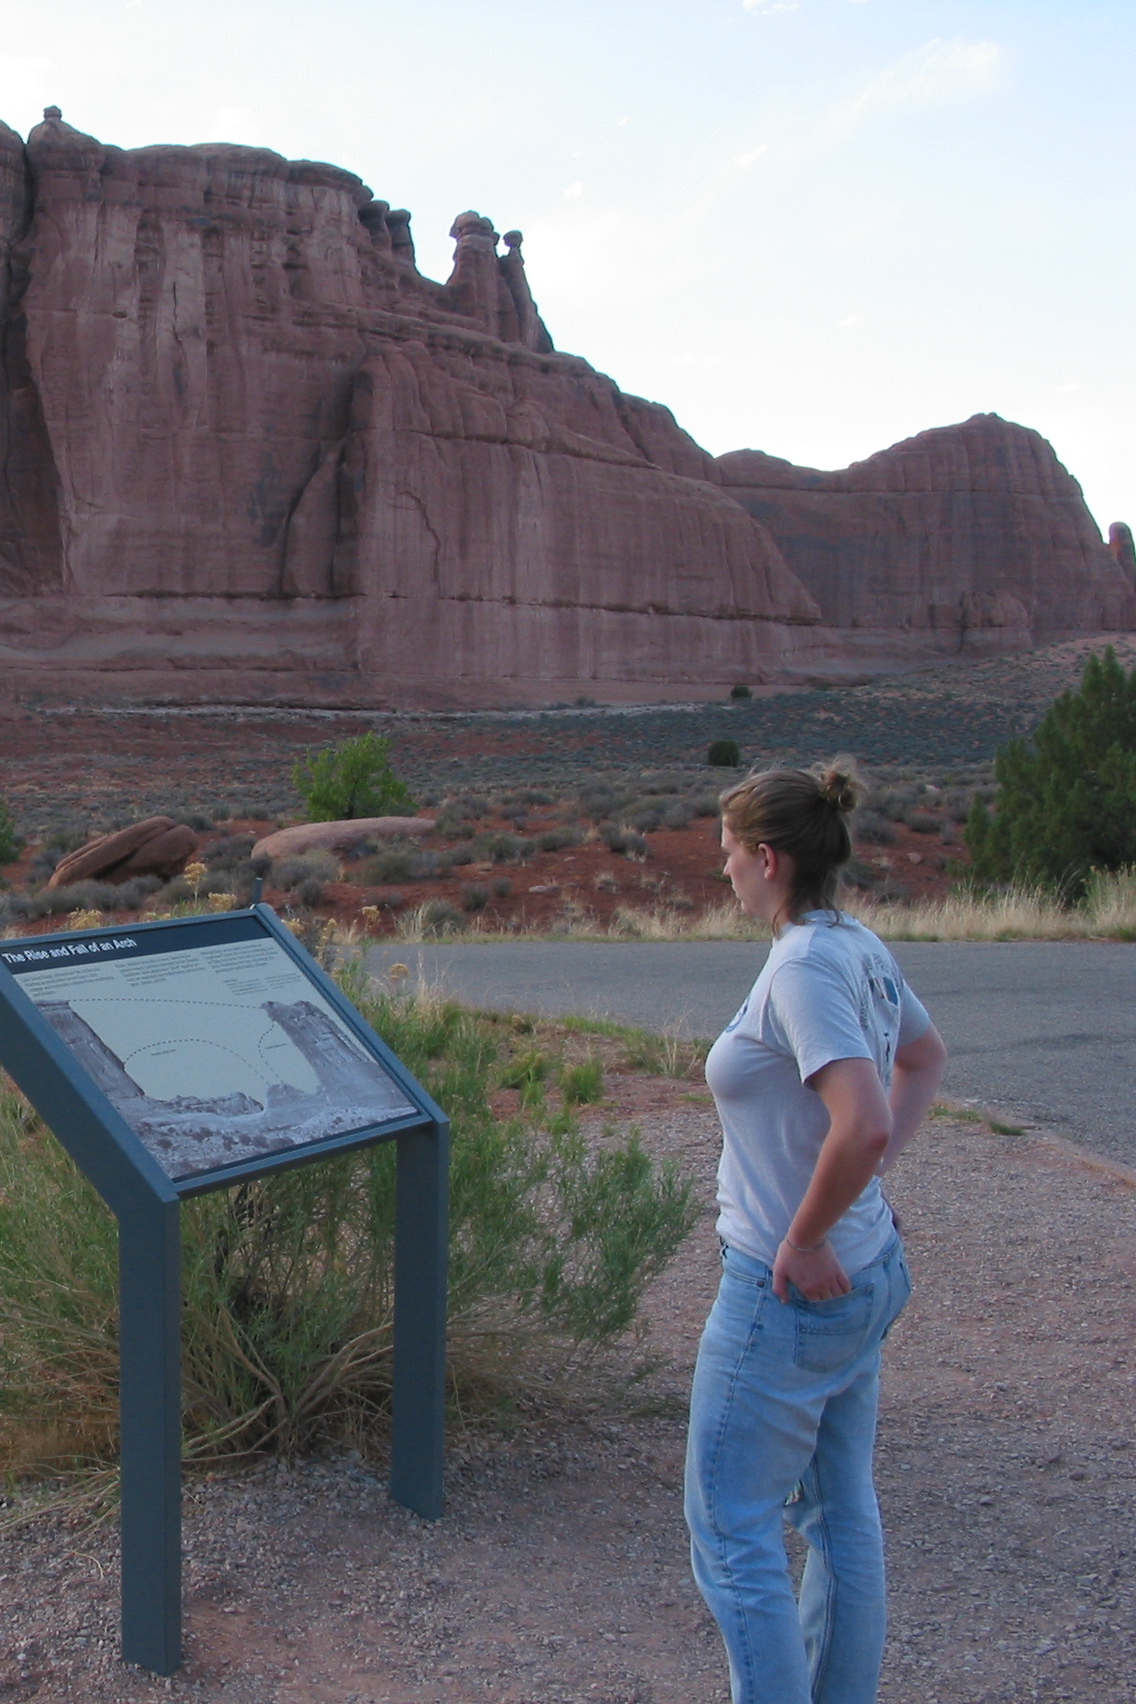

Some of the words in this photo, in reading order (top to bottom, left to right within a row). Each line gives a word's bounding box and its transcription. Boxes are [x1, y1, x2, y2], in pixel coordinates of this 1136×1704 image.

[2, 953, 25, 963] The
[24, 950, 49, 960] Rise
[50, 946, 70, 957] and
[67, 944, 89, 955] Fall
[88, 942, 102, 952] of
[101, 943, 114, 951] an
[112, 938, 137, 949] Arch
